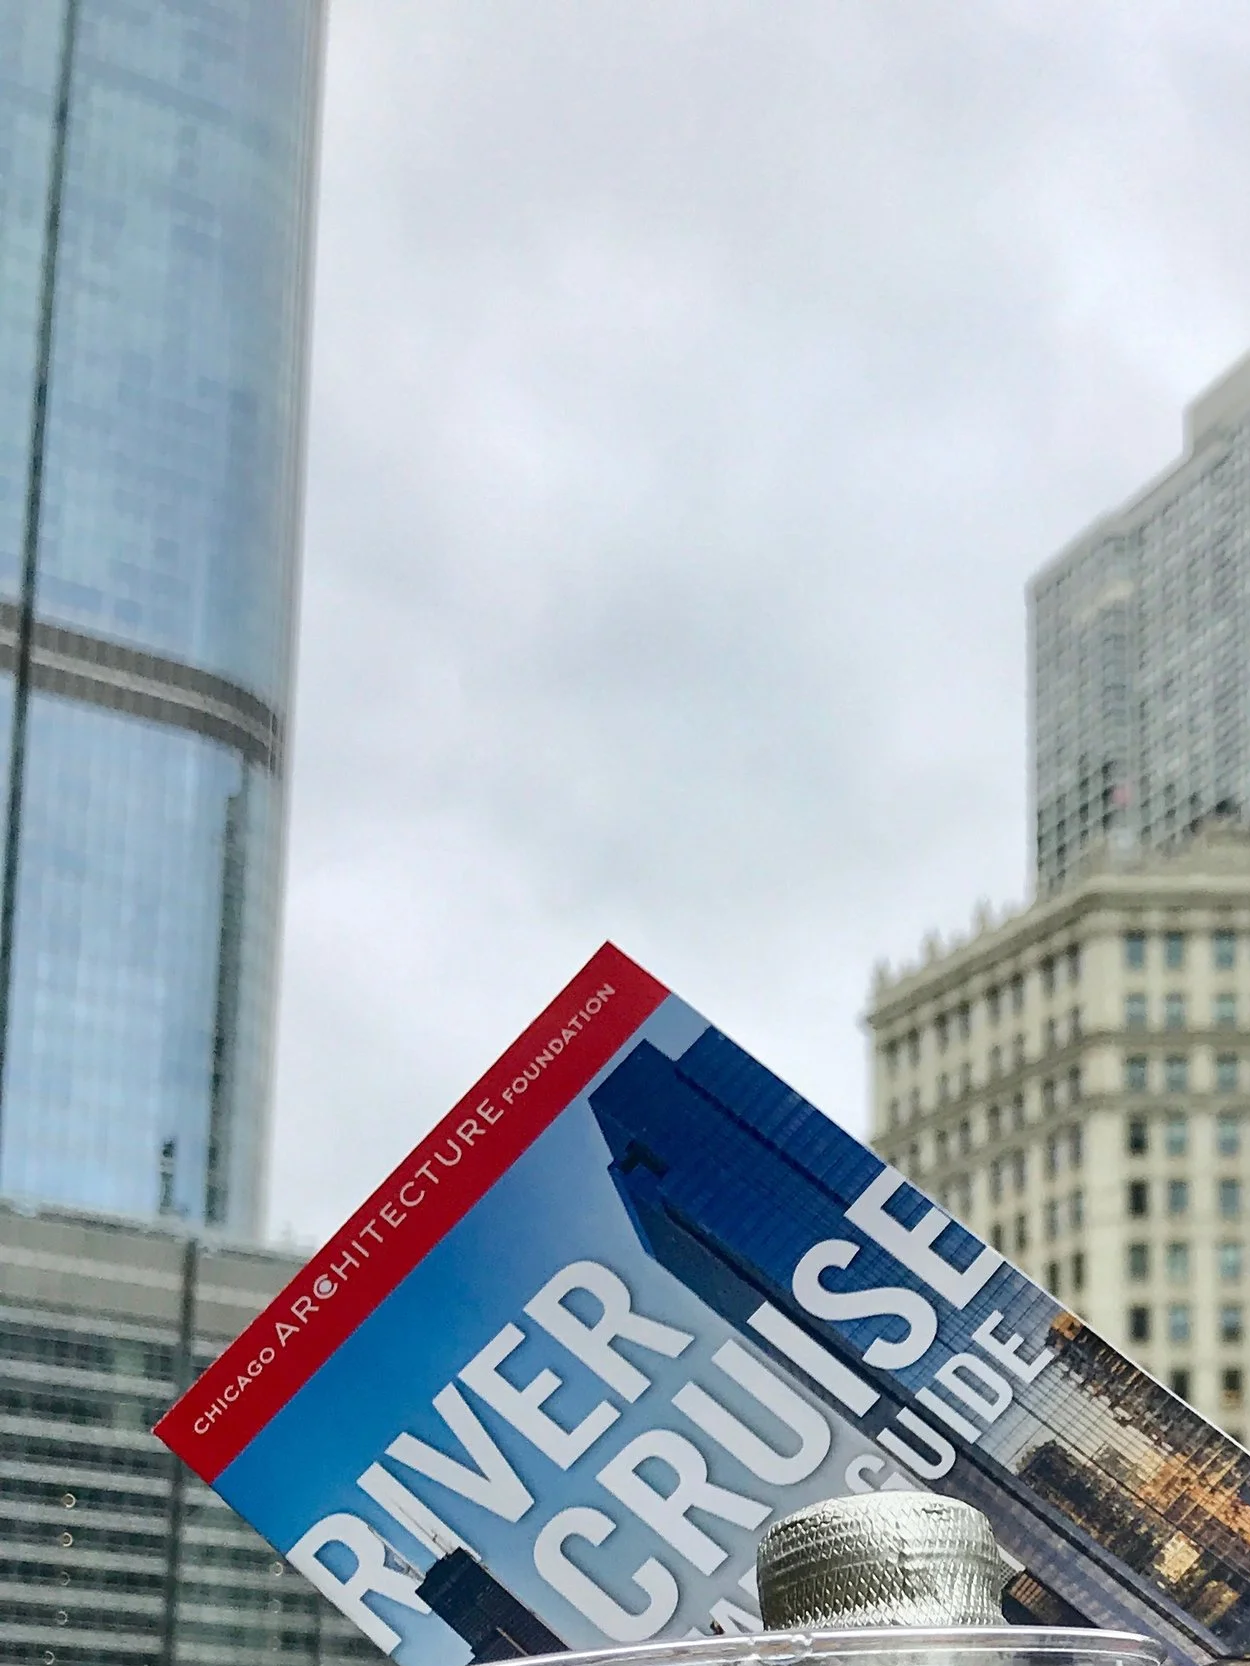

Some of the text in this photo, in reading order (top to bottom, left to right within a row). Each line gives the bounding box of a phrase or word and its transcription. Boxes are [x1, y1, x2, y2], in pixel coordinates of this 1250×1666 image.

[193, 982, 616, 1434] CHICAGO ARCHITECTURE FOUNDATION
[533, 1166, 1005, 1644] CRUISE
[286, 1259, 695, 1653] RIVER
